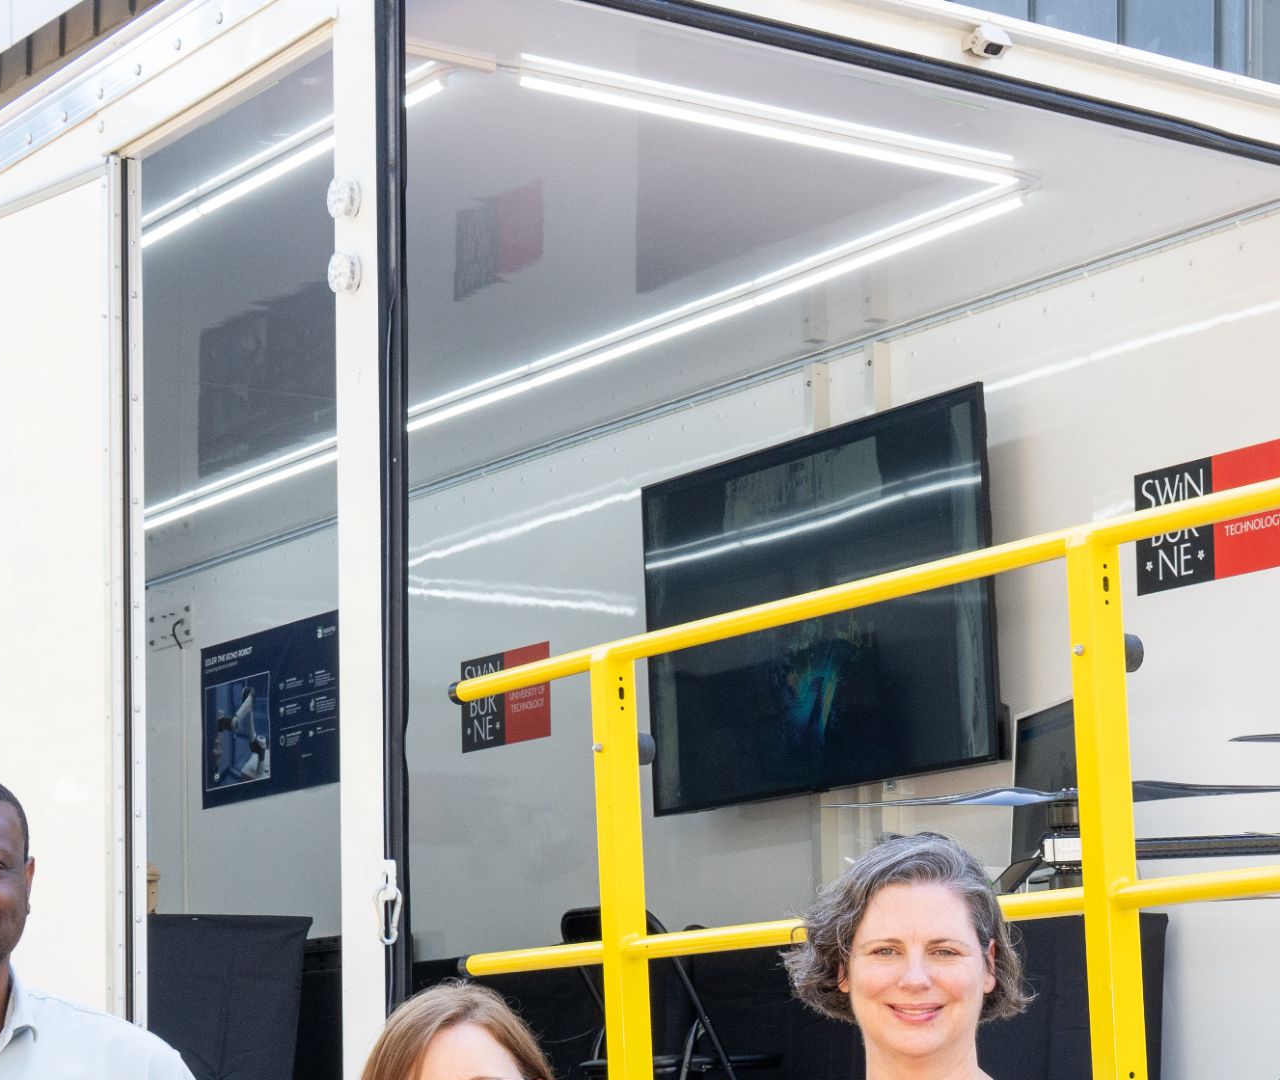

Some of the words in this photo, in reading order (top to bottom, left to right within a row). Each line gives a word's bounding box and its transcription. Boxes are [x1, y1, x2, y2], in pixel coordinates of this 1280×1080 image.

[1158, 543, 1194, 581] NE
[509, 686, 538, 701] UNIVERSITY
[510, 699, 545, 713] TECHNOLOGY
[473, 715, 494, 743] NE
